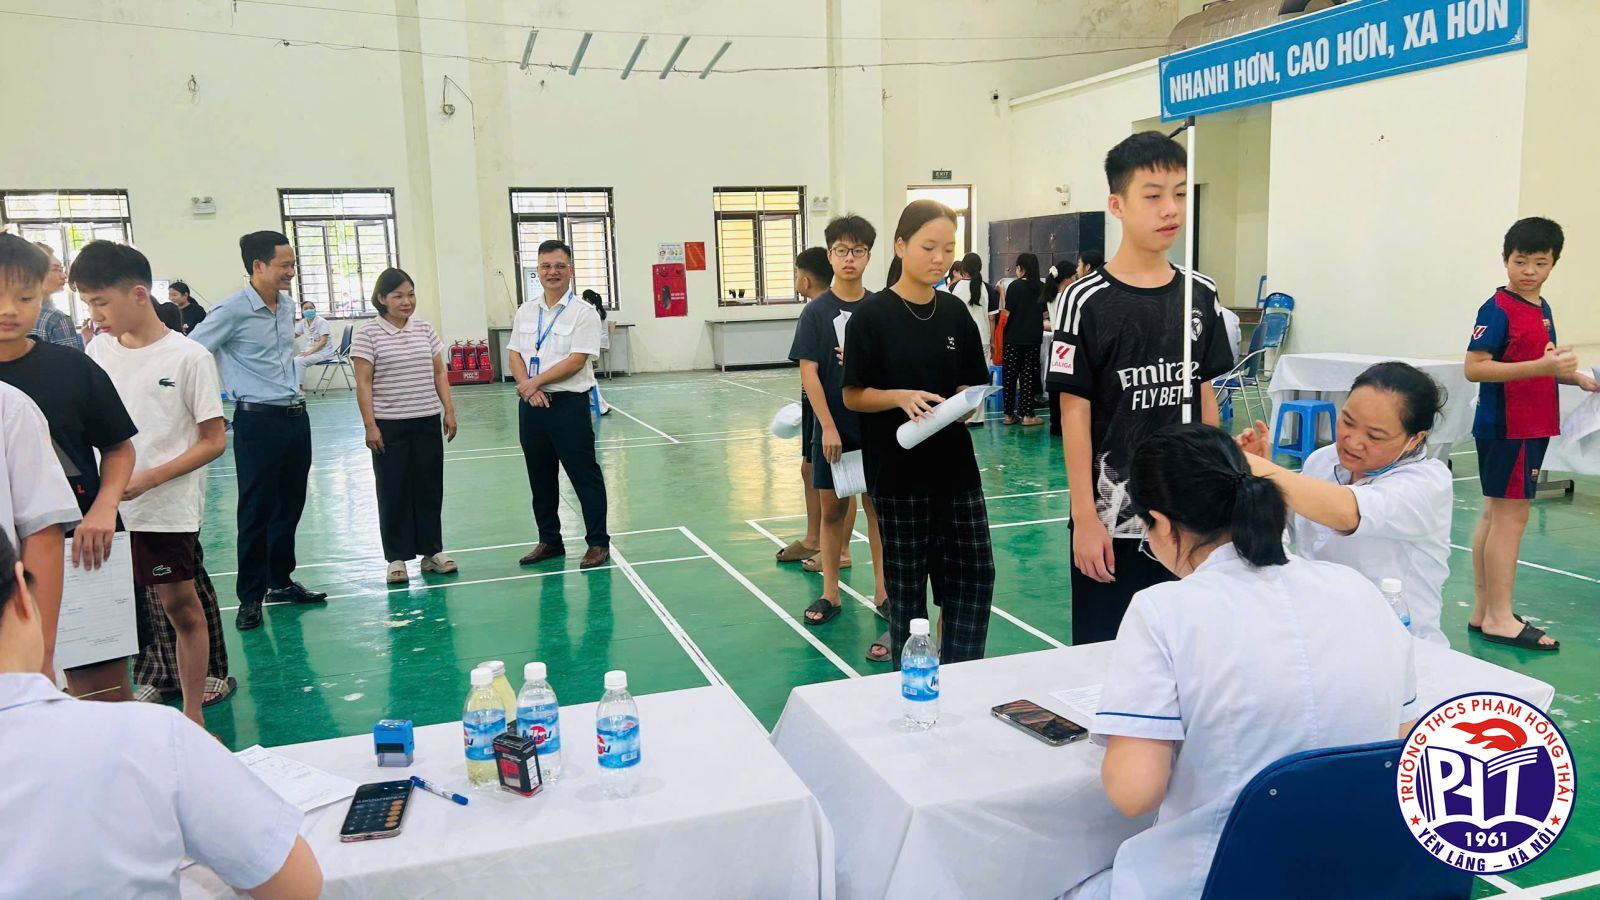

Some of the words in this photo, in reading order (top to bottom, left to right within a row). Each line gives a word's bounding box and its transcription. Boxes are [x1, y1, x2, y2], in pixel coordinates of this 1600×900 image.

[1169, 64, 1229, 103] NHANH
[1234, 50, 1280, 89] HƠN,
[1287, 38, 1329, 77] CAO
[1337, 21, 1394, 70] HƠN,
[1402, 8, 1438, 51] XA
[1117, 358, 1201, 391] Emirae
[1131, 387, 1159, 411] FLY
